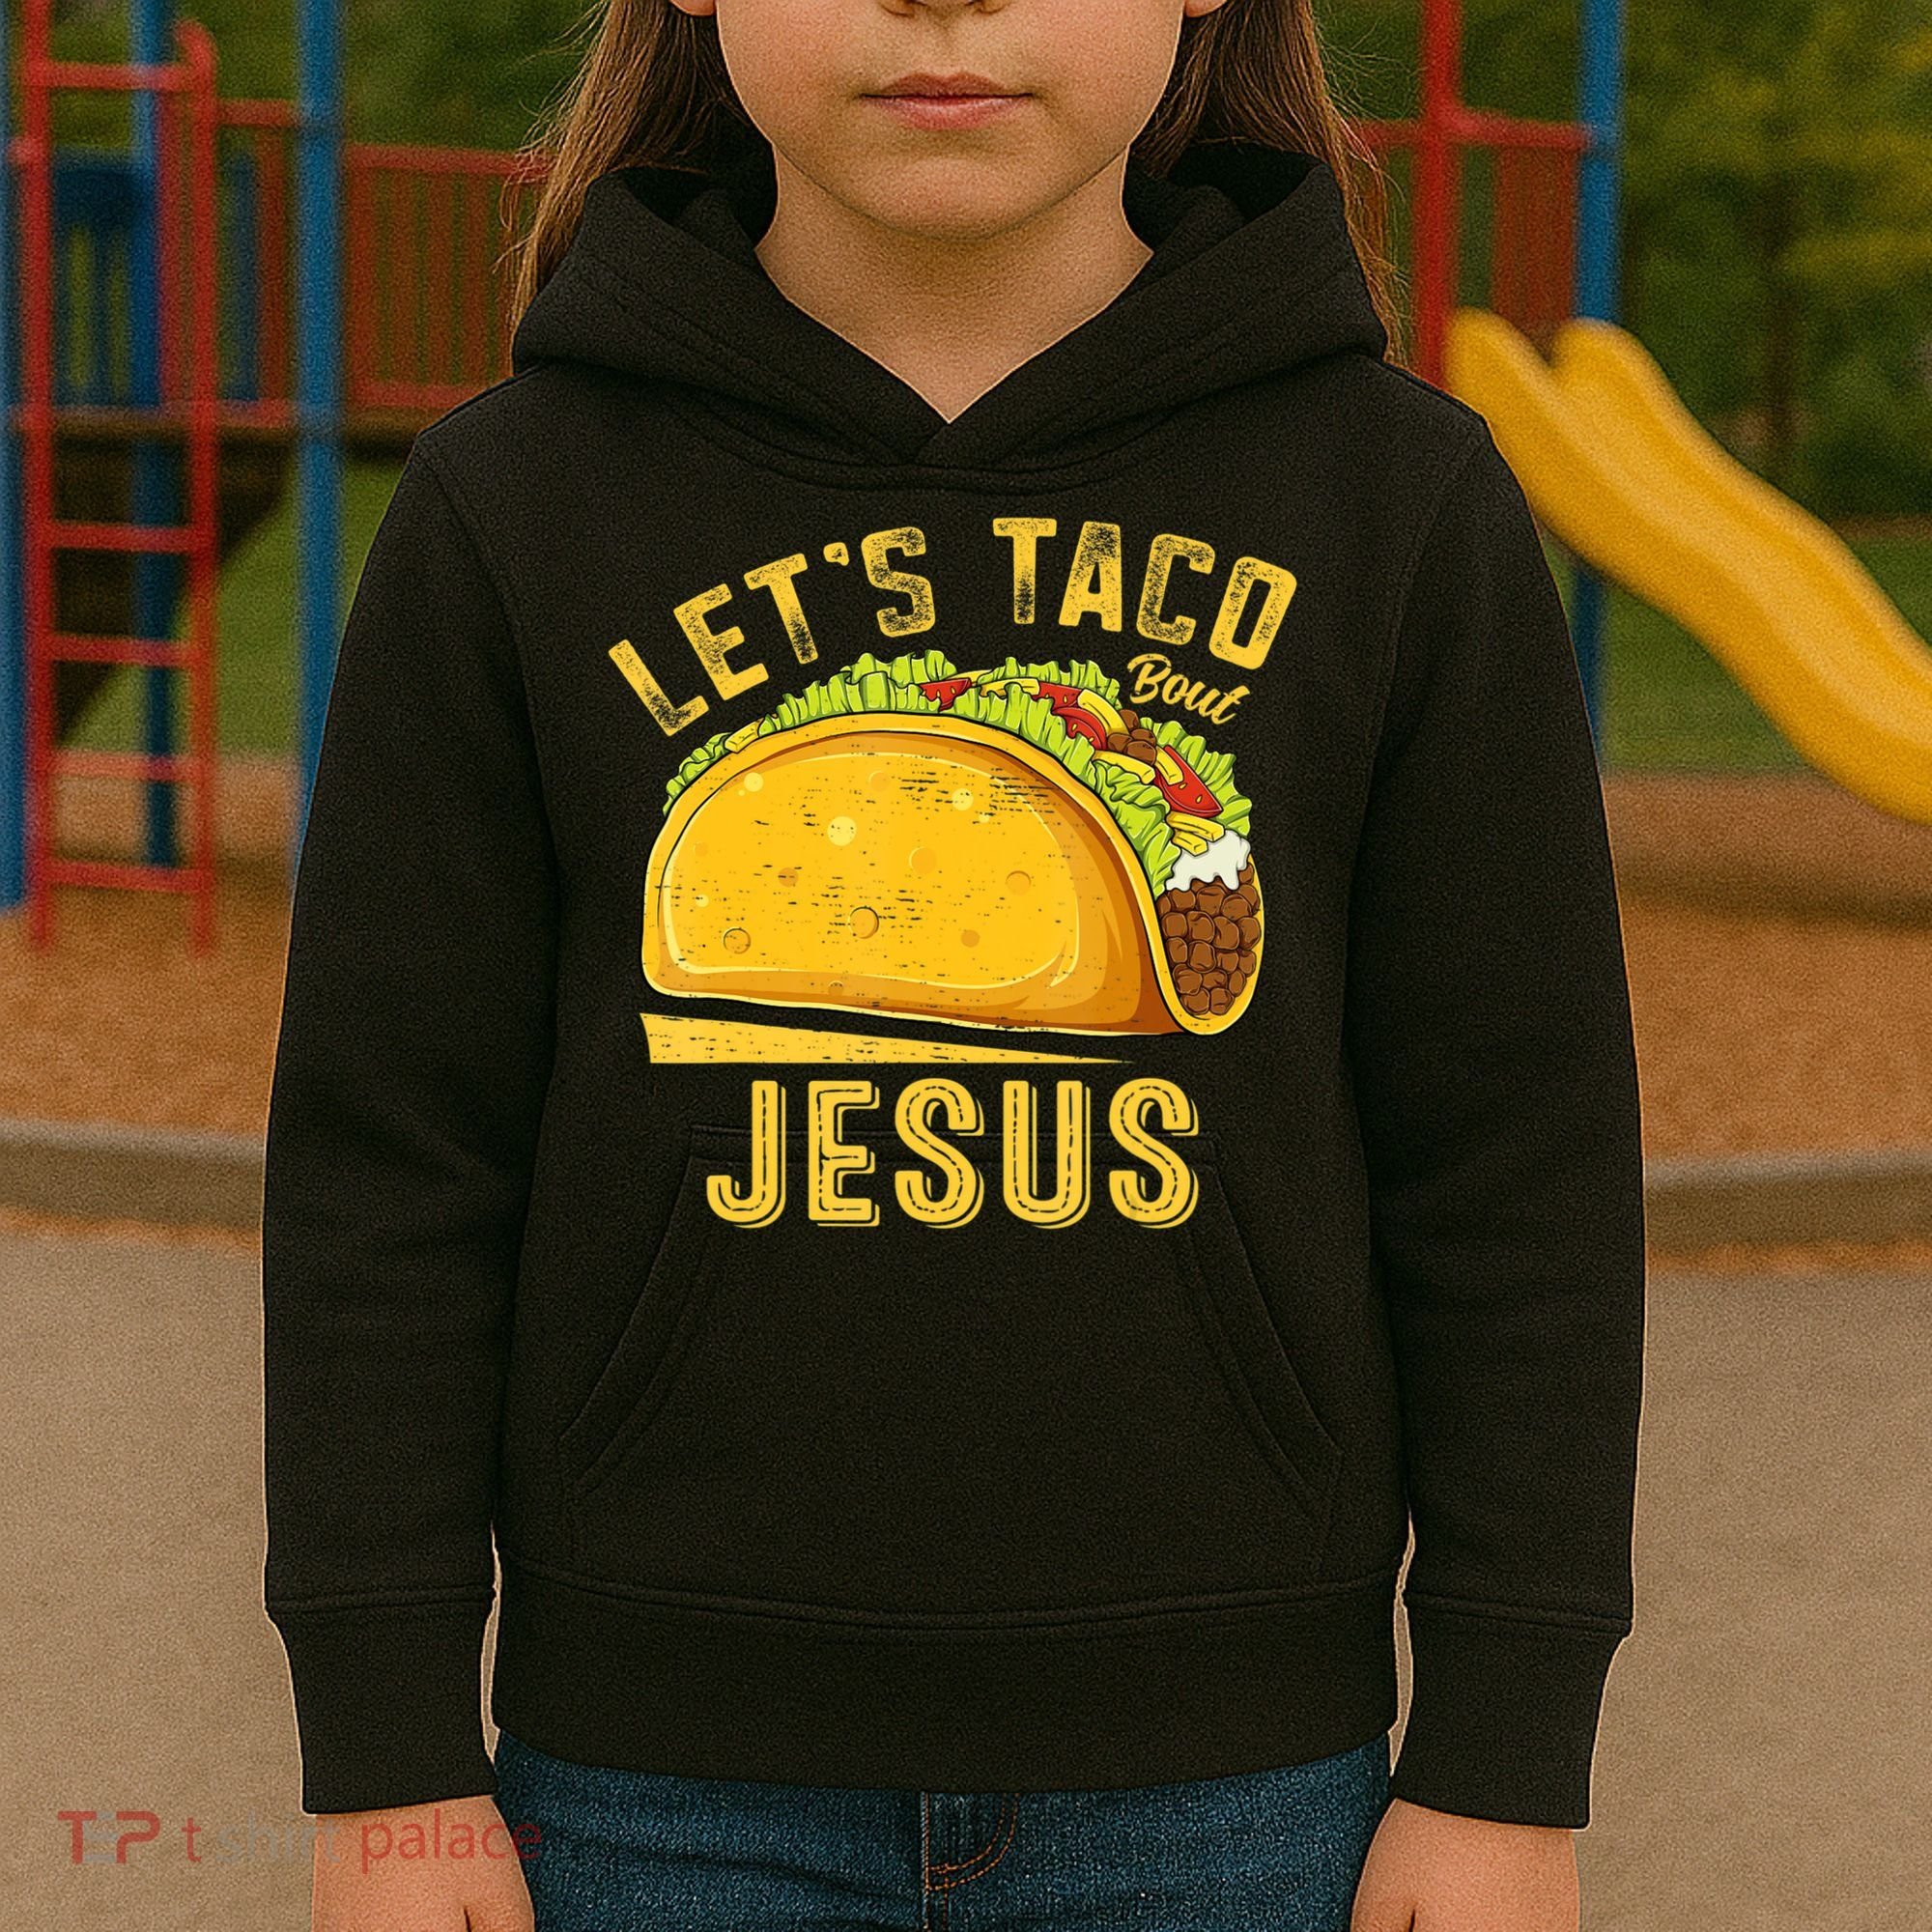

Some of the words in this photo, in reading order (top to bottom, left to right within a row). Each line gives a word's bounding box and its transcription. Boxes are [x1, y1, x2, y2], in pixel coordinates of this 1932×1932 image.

[609, 526, 936, 736] LET'S
[993, 518, 1297, 669] TACO
[1127, 653, 1250, 724] Bout
[706, 1078, 1199, 1229] JESUS
